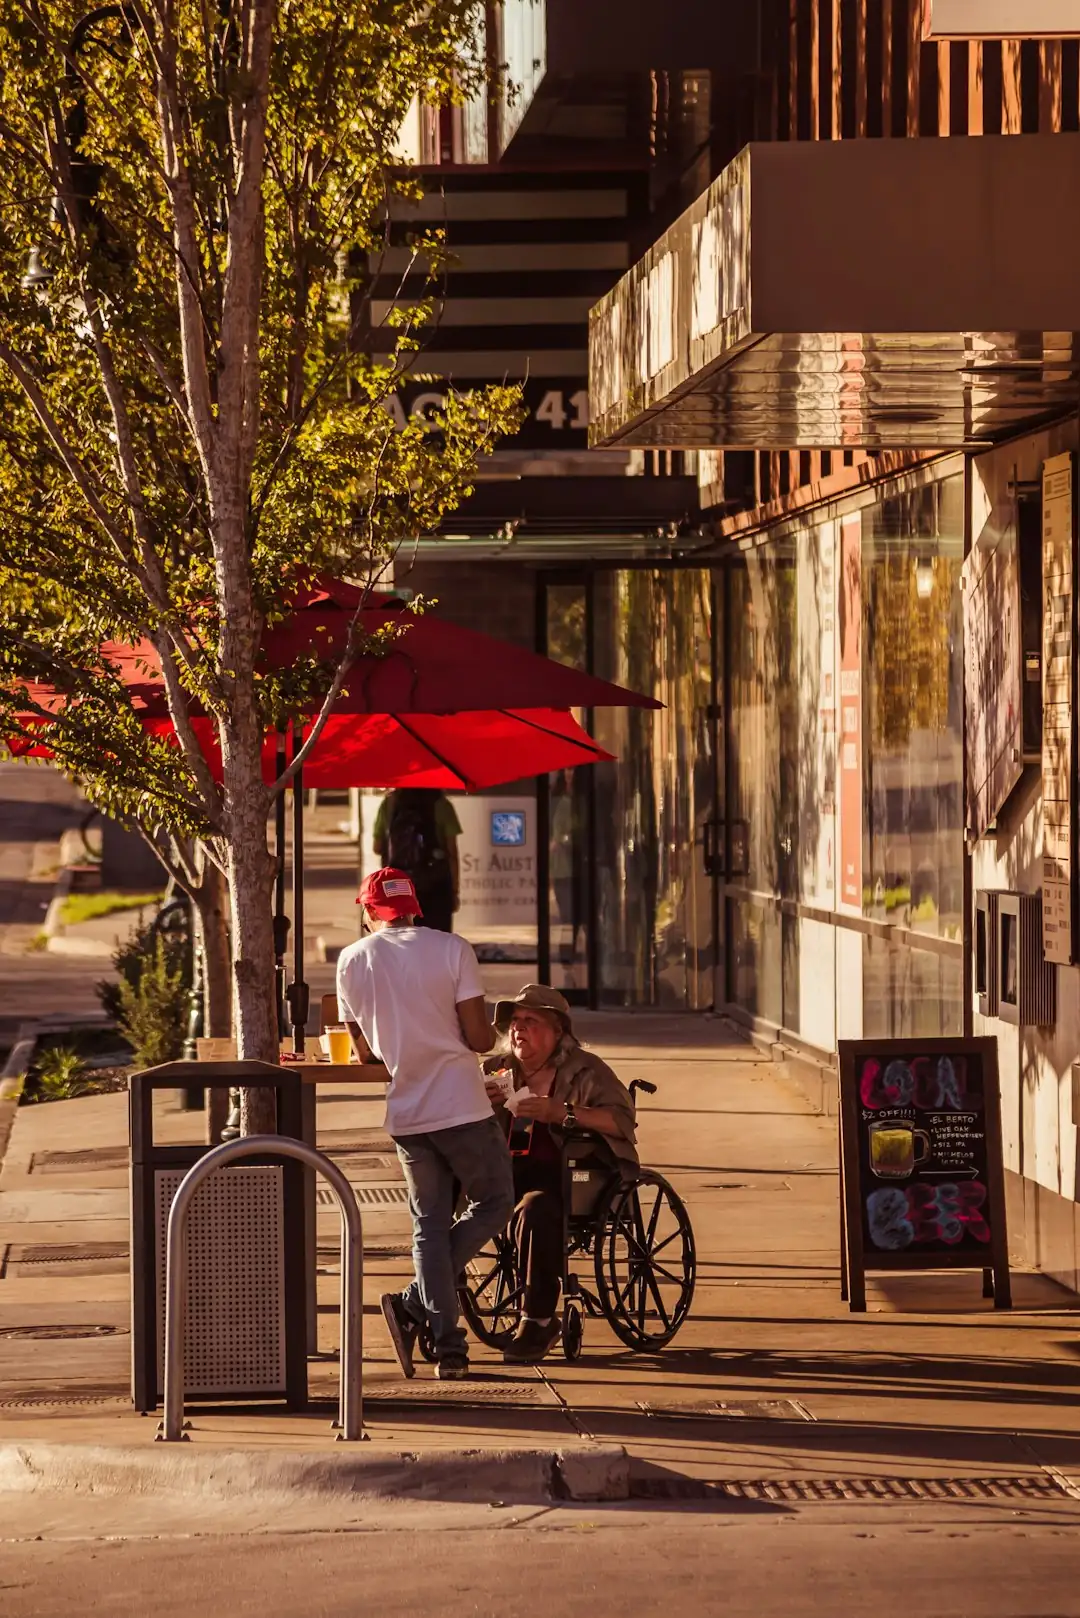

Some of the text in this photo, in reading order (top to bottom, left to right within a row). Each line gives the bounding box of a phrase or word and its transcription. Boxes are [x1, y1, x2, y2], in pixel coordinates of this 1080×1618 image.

[463, 877, 513, 890] THOLIC
[860, 1056, 982, 1109] LOCAL
[861, 1108, 916, 1120] $2 OFF!!!!
[932, 1115, 943, 1124] EL
